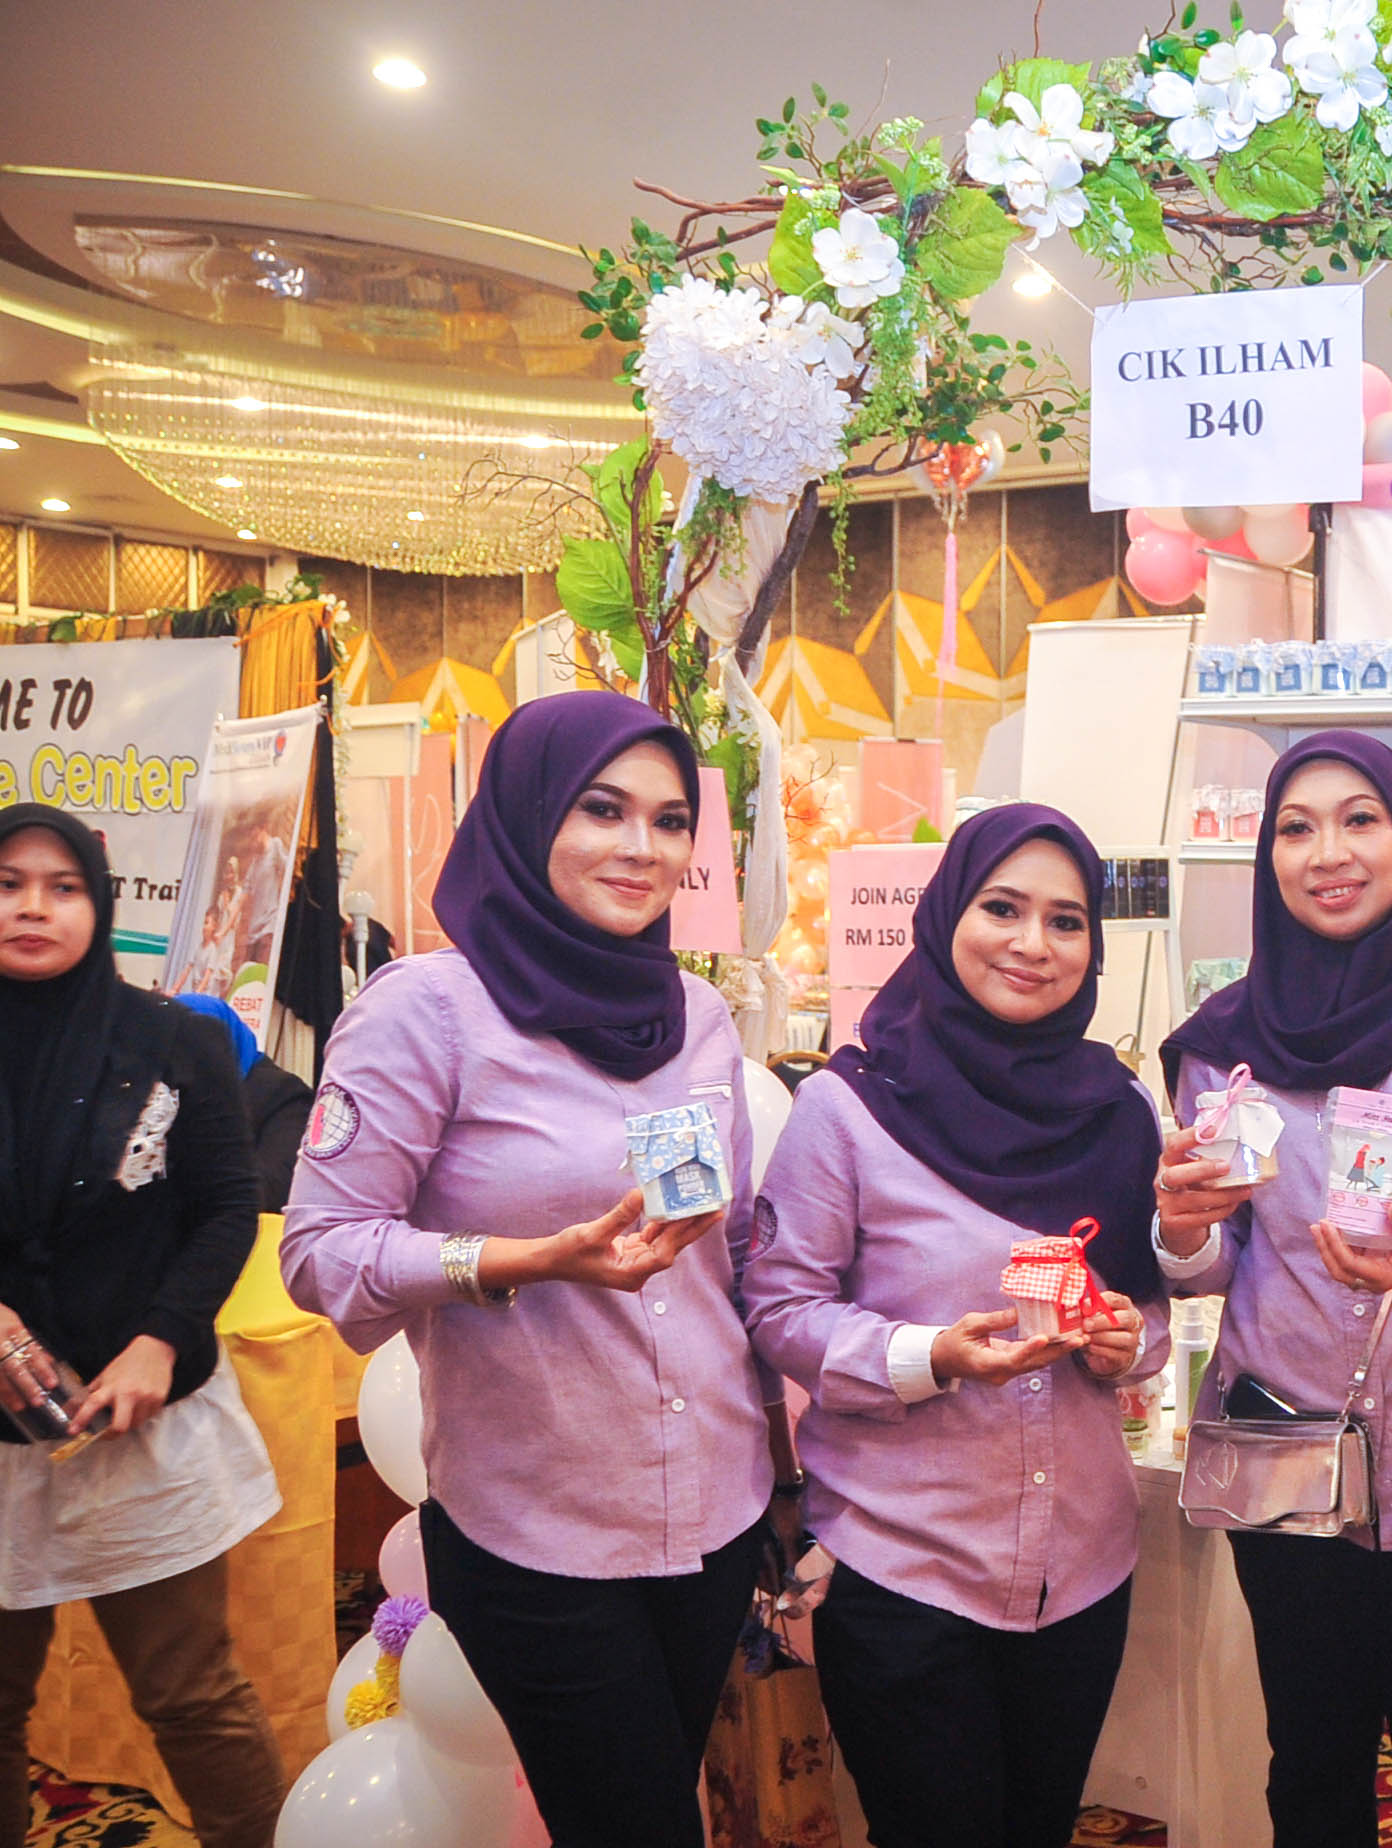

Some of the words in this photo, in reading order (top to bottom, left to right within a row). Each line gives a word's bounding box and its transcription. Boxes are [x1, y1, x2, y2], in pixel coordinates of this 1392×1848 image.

[1117, 347, 1187, 383] CIK
[1196, 336, 1335, 377] ILHAM
[1185, 398, 1264, 440] B40
[50, 676, 95, 732] TO
[30, 742, 200, 817] Center
[850, 886, 887, 906] JOIN
[845, 928, 872, 947] RM
[877, 928, 907, 947] 150
